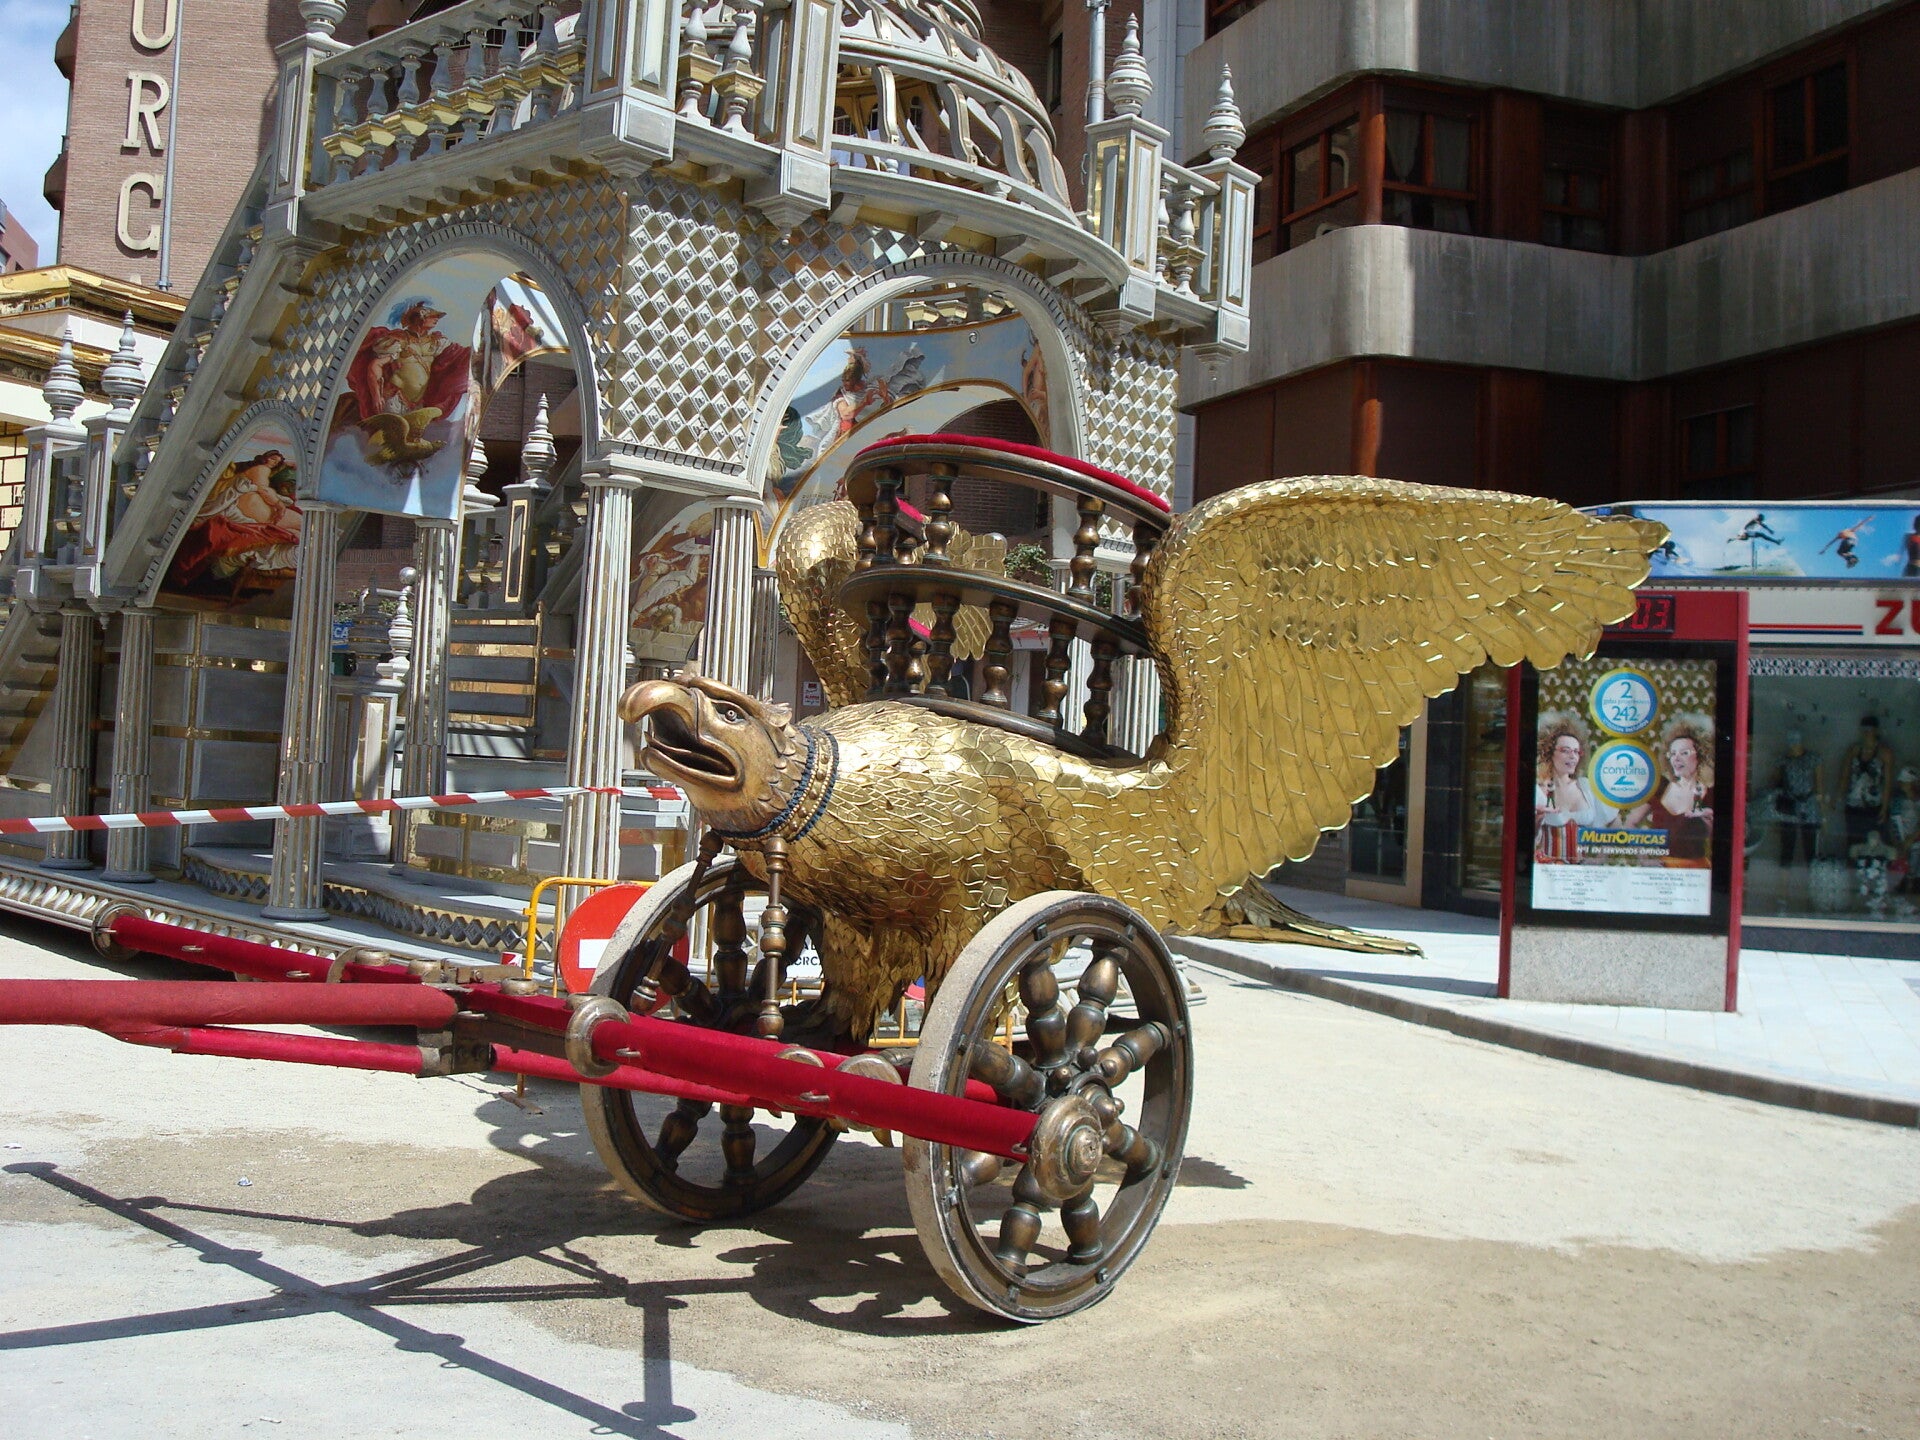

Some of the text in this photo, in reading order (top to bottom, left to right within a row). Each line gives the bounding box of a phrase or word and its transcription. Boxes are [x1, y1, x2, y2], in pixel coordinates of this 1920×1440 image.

[1618, 598, 1671, 630] 03
[1620, 681, 1633, 699] 2
[1602, 765, 1647, 776] combina
[1603, 847, 1638, 856] SERVICIOS
